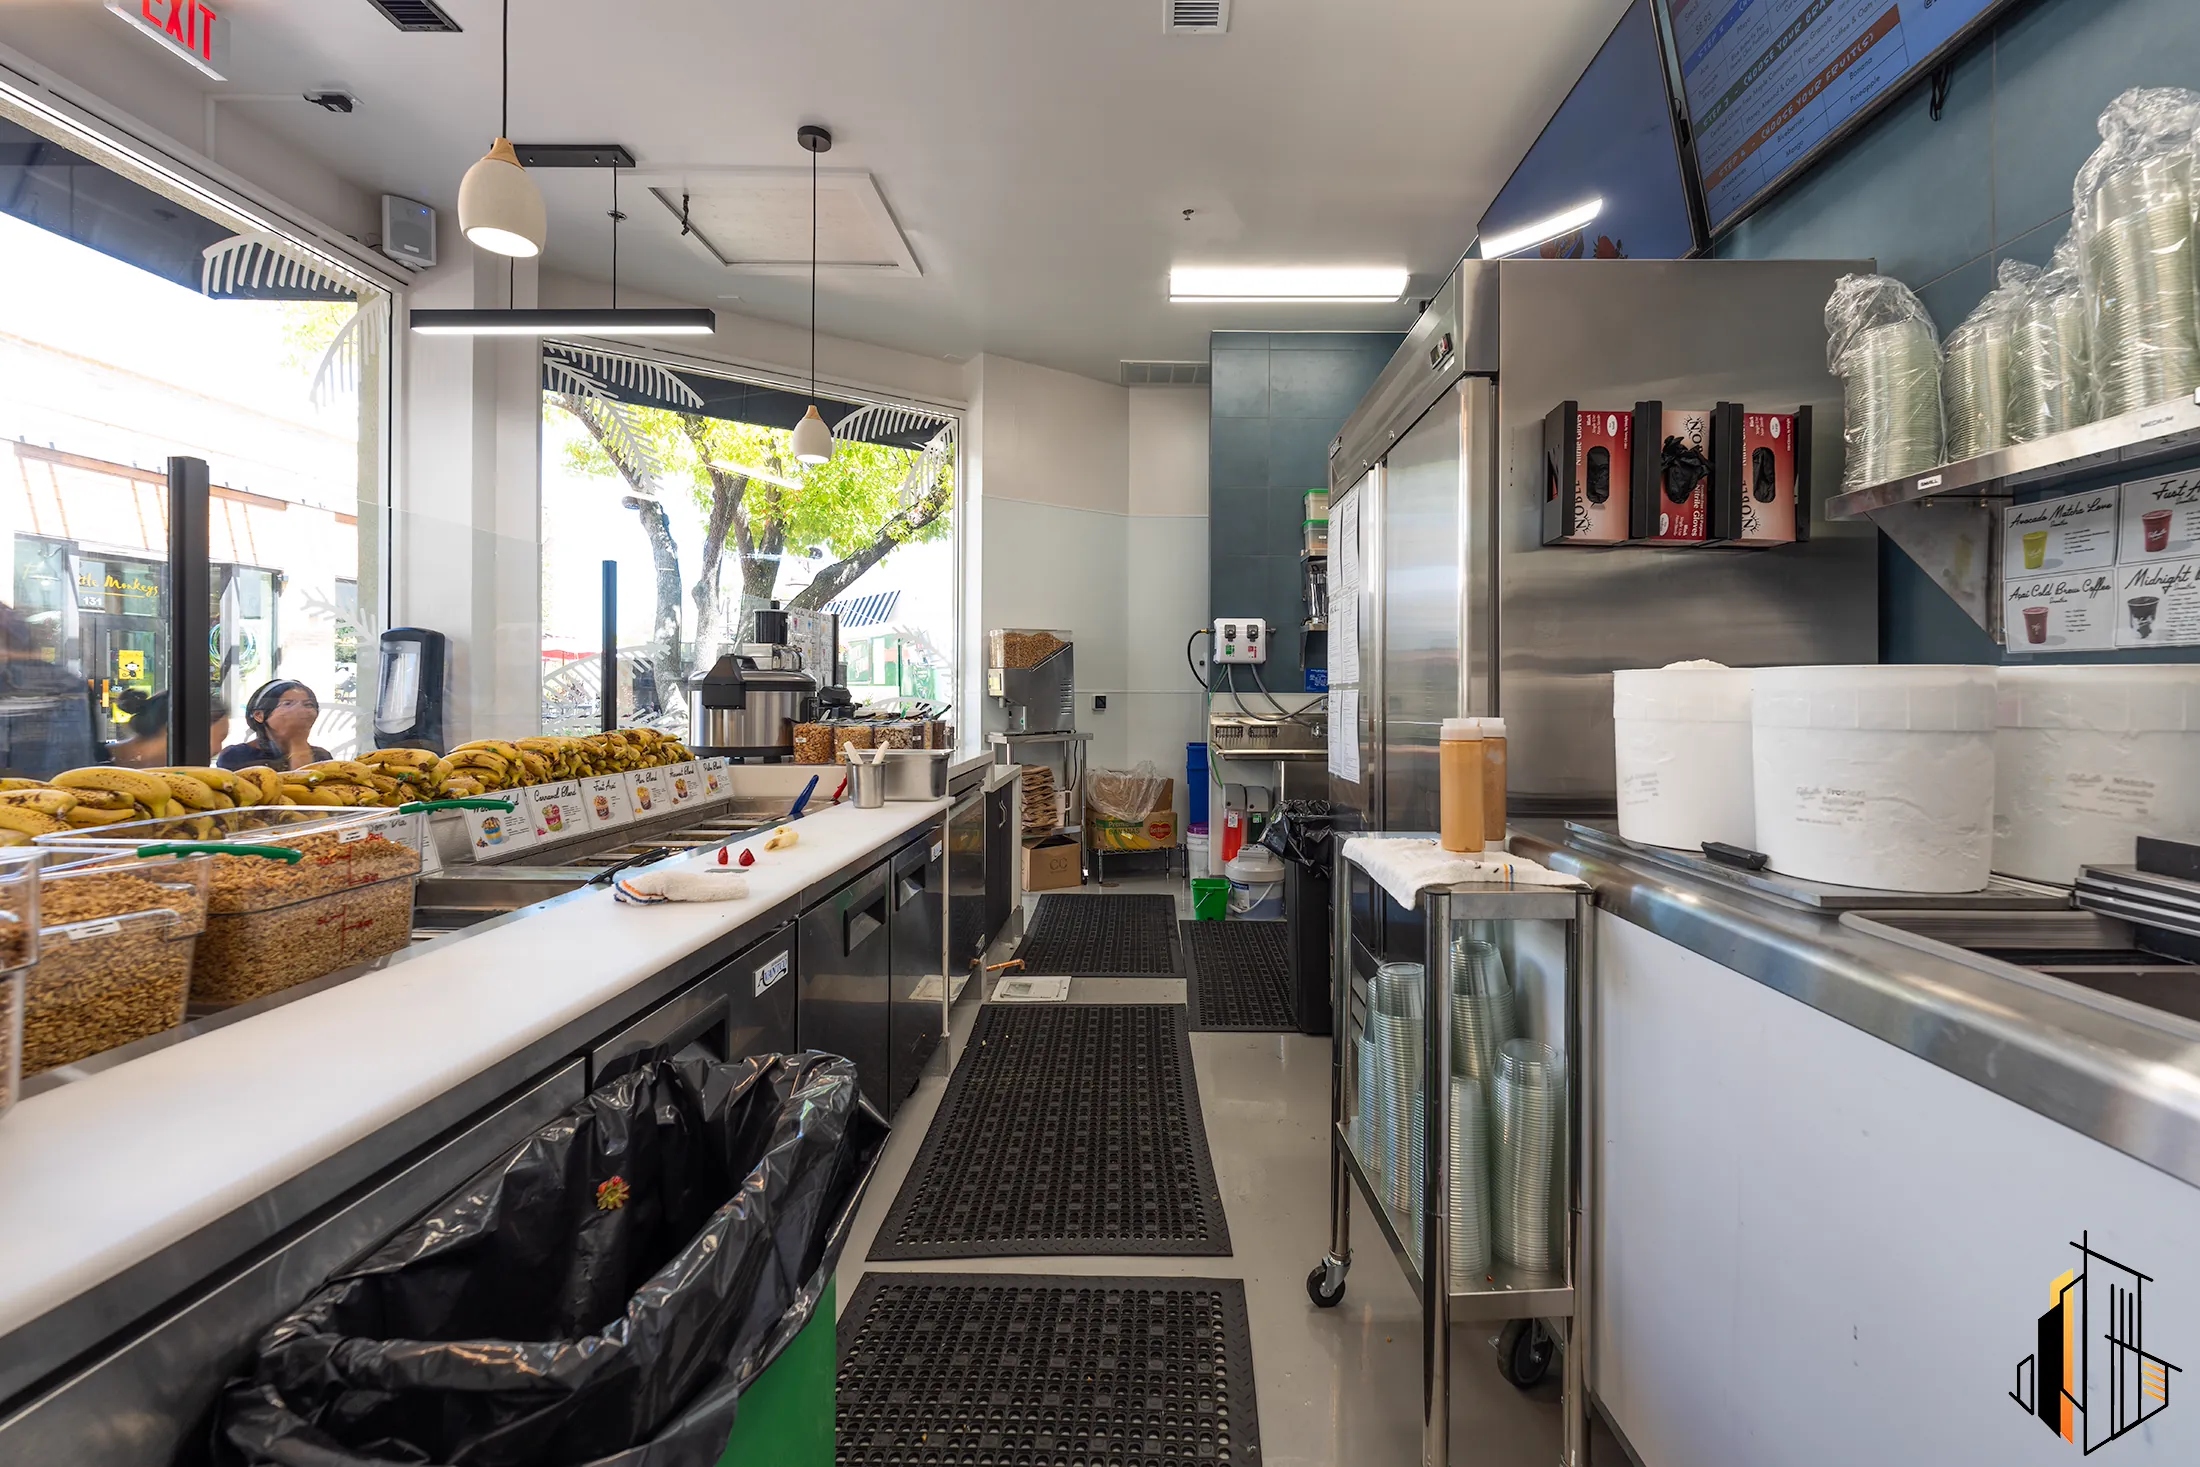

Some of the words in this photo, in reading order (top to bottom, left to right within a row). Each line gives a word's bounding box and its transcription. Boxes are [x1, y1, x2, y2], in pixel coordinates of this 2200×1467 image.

[1698, 33, 1717, 57] STEP
[1808, 41, 1830, 65] Roasted
[1830, 23, 1850, 42] Coffee
[1703, 105, 1721, 127] STEP
[1743, 50, 1775, 86] CHOOSE
[1777, 22, 1802, 50] YOUR
[1849, 57, 1873, 80] Banana
[1850, 75, 1881, 103] Pineapple
[1718, 155, 1738, 177] STEP
[1760, 105, 1794, 139] CHOOSE
[1796, 79, 1822, 106] YOUR
[1825, 33, 1874, 82] FRUIT(S)
[1784, 141, 1804, 158] Mango
[2140, 415, 2174, 428] MEDIUM
[1693, 484, 1701, 509] Nitrile
[1691, 510, 1700, 537] Gloves
[2009, 508, 2047, 528] Avocado
[2048, 501, 2085, 521] Matcha
[2087, 498, 2113, 513] Love
[104, 575, 158, 597] Monkeys
[2031, 583, 2054, 598] Cold
[2055, 581, 2080, 595] Brew
[2082, 576, 2112, 599] Coffee
[2124, 564, 2192, 594] Midnight
[83, 597, 102, 606] 131
[561, 784, 577, 797] Blend
[1050, 858, 1067, 870] CC
